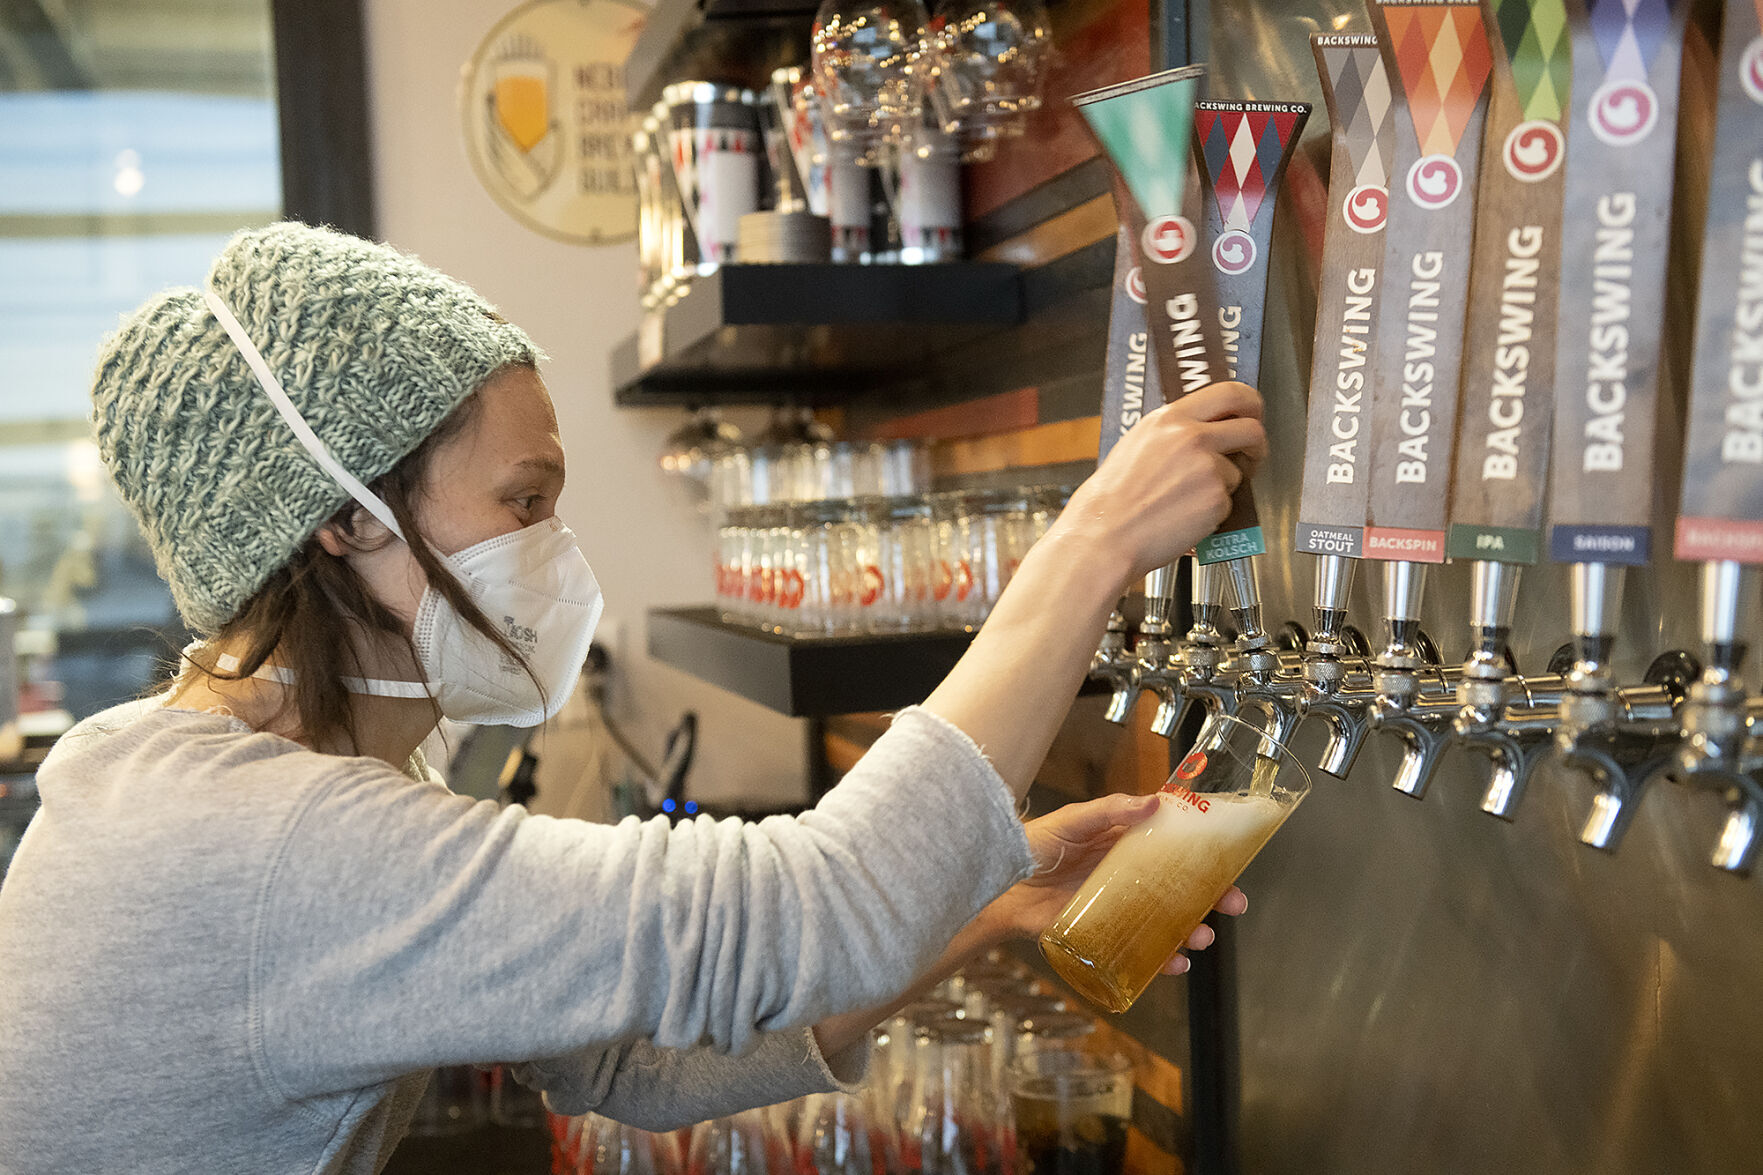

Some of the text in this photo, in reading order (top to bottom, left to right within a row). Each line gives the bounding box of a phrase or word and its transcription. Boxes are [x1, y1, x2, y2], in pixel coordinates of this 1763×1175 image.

[1245, 103, 1288, 112] BREWING
[1290, 105, 1307, 113] CO.
[1583, 192, 1637, 473] BACKSWING
[1218, 305, 1242, 379] ING
[1482, 226, 1544, 481] BACKSWING
[1326, 267, 1377, 485] BACKSWING
[1396, 251, 1444, 485] BACKSWING
[1210, 532, 1249, 548] CITRA
[1311, 529, 1354, 541] OATMEAL
[1476, 534, 1504, 550] IPA
[1308, 538, 1354, 553] STOUT
[1369, 536, 1437, 551] BACKSPIN
